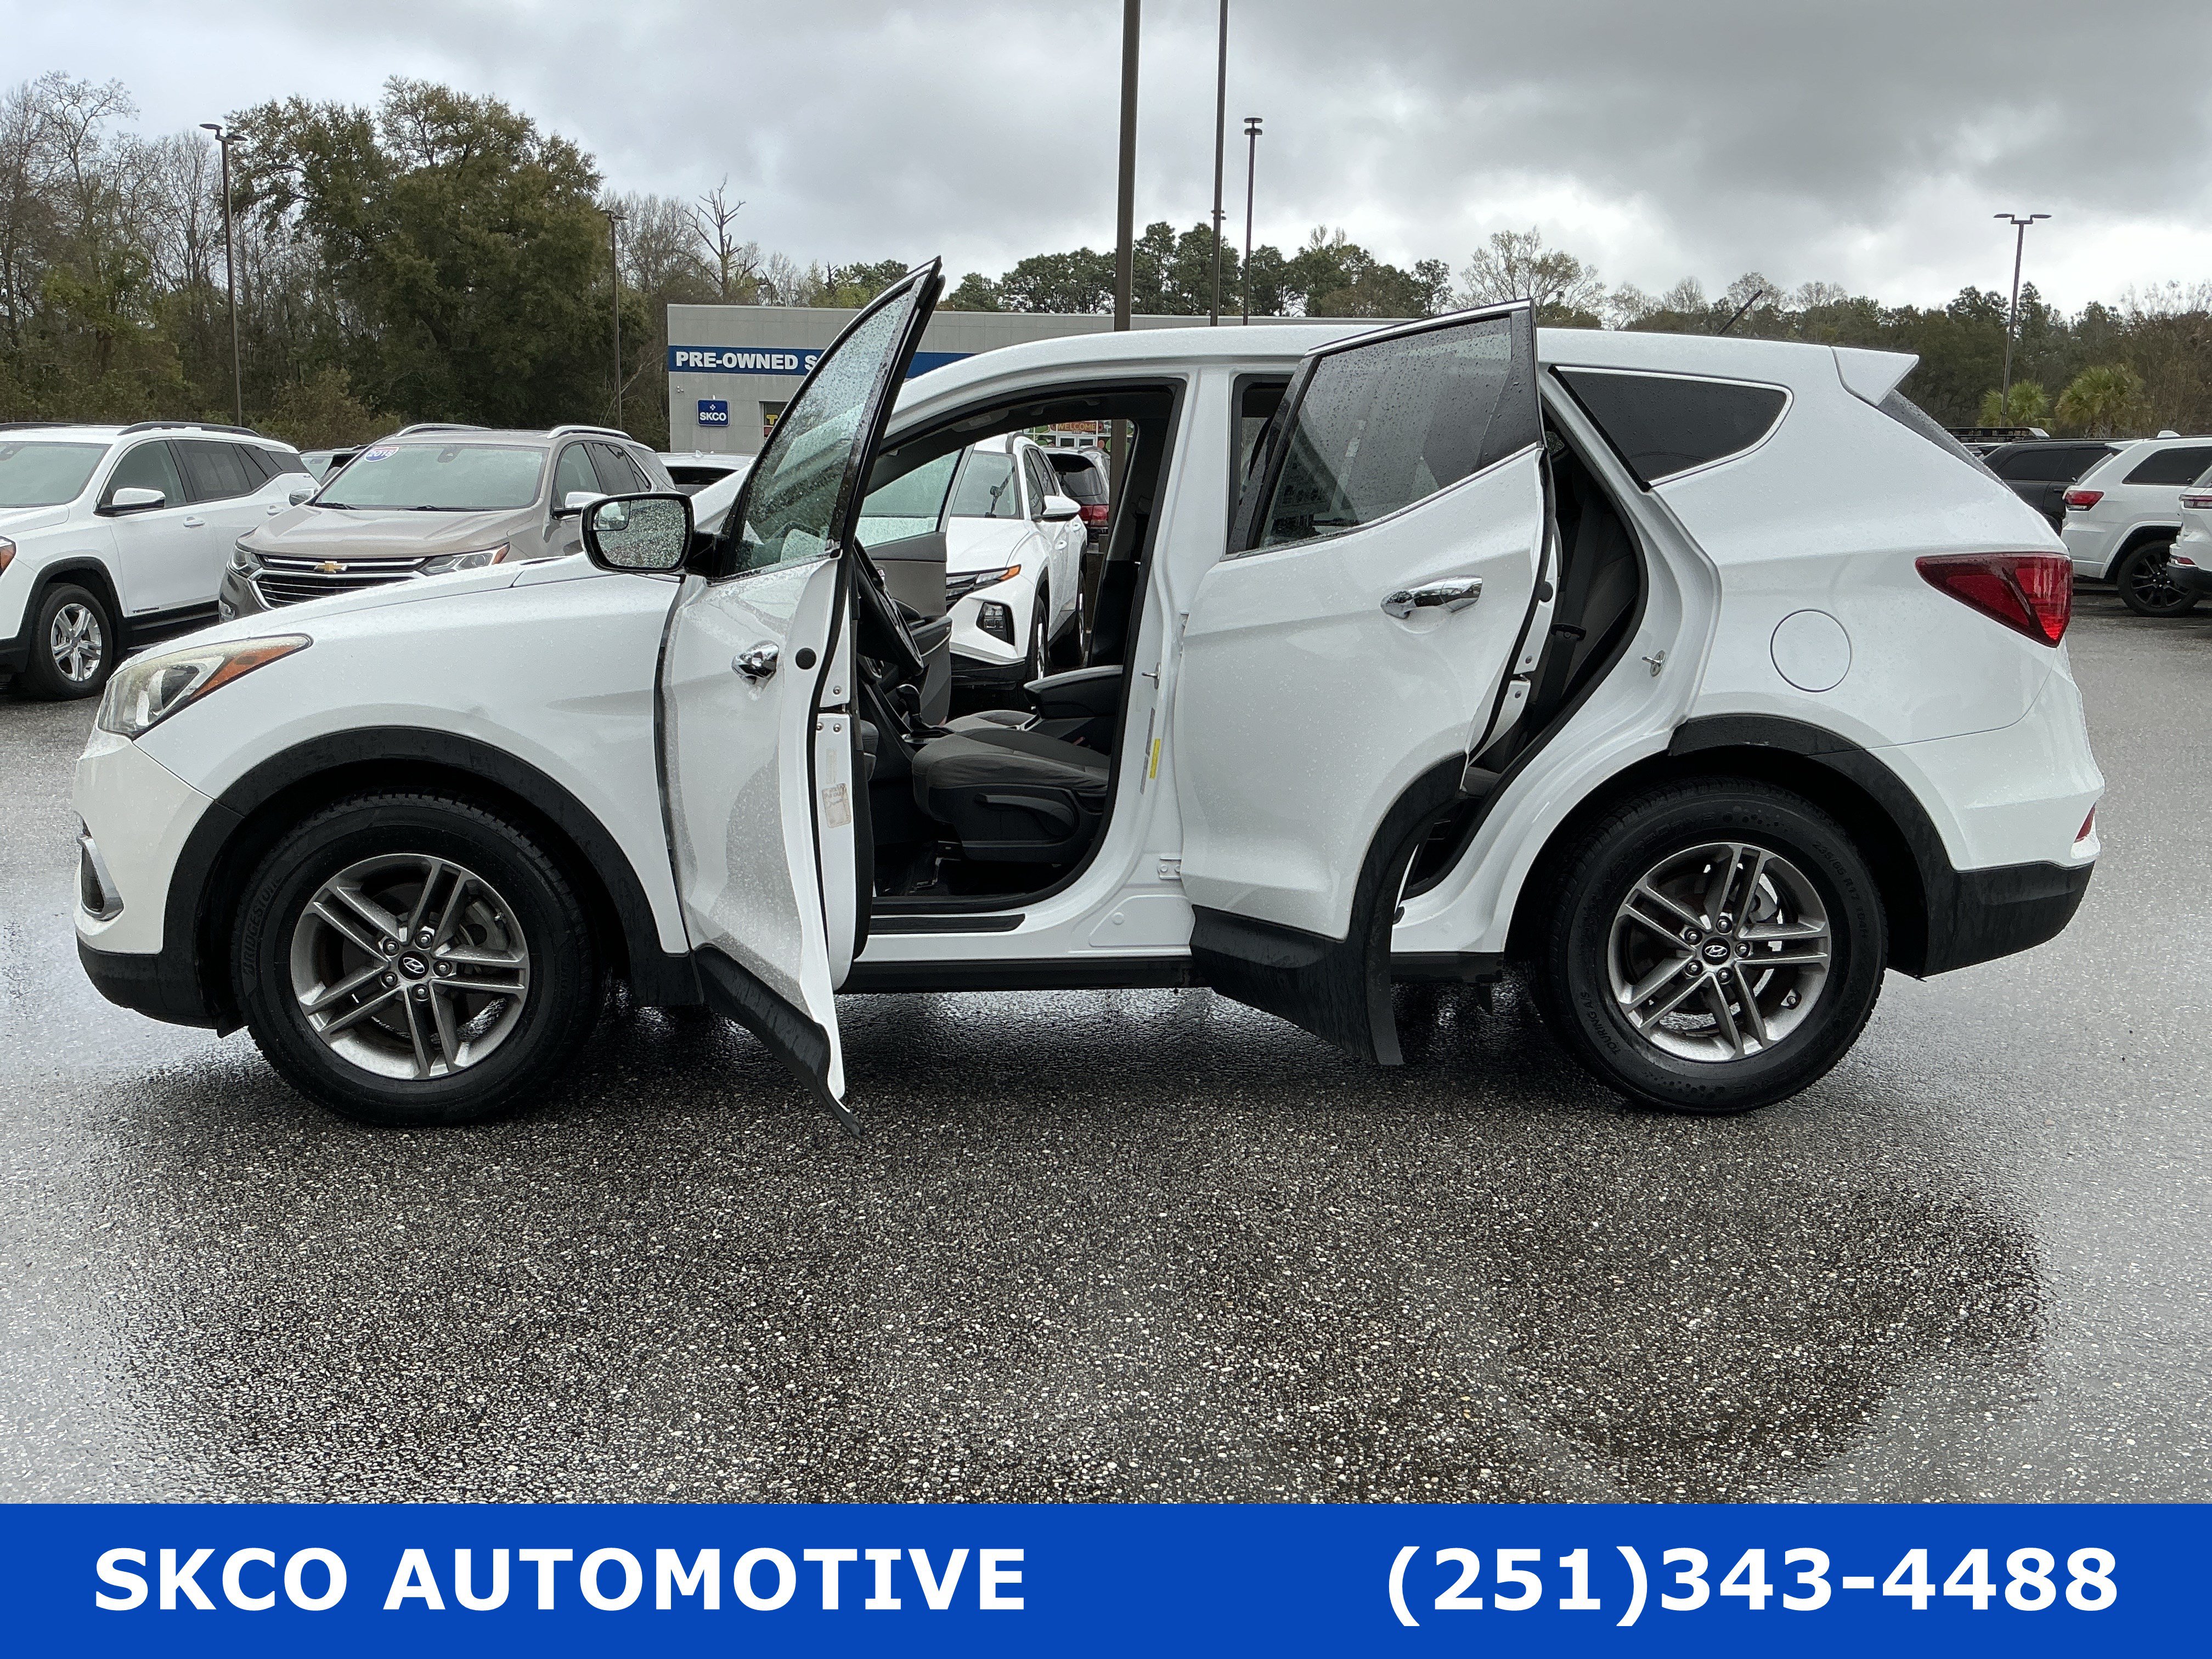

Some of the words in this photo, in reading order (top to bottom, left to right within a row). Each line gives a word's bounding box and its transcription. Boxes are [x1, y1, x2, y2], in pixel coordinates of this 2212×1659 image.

[676, 351, 798, 370] PRE-OWNED
[699, 411, 727, 421] SKCO
[1058, 422, 1096, 431] WELCOME
[1589, 1011, 1621, 1055] TOURING
